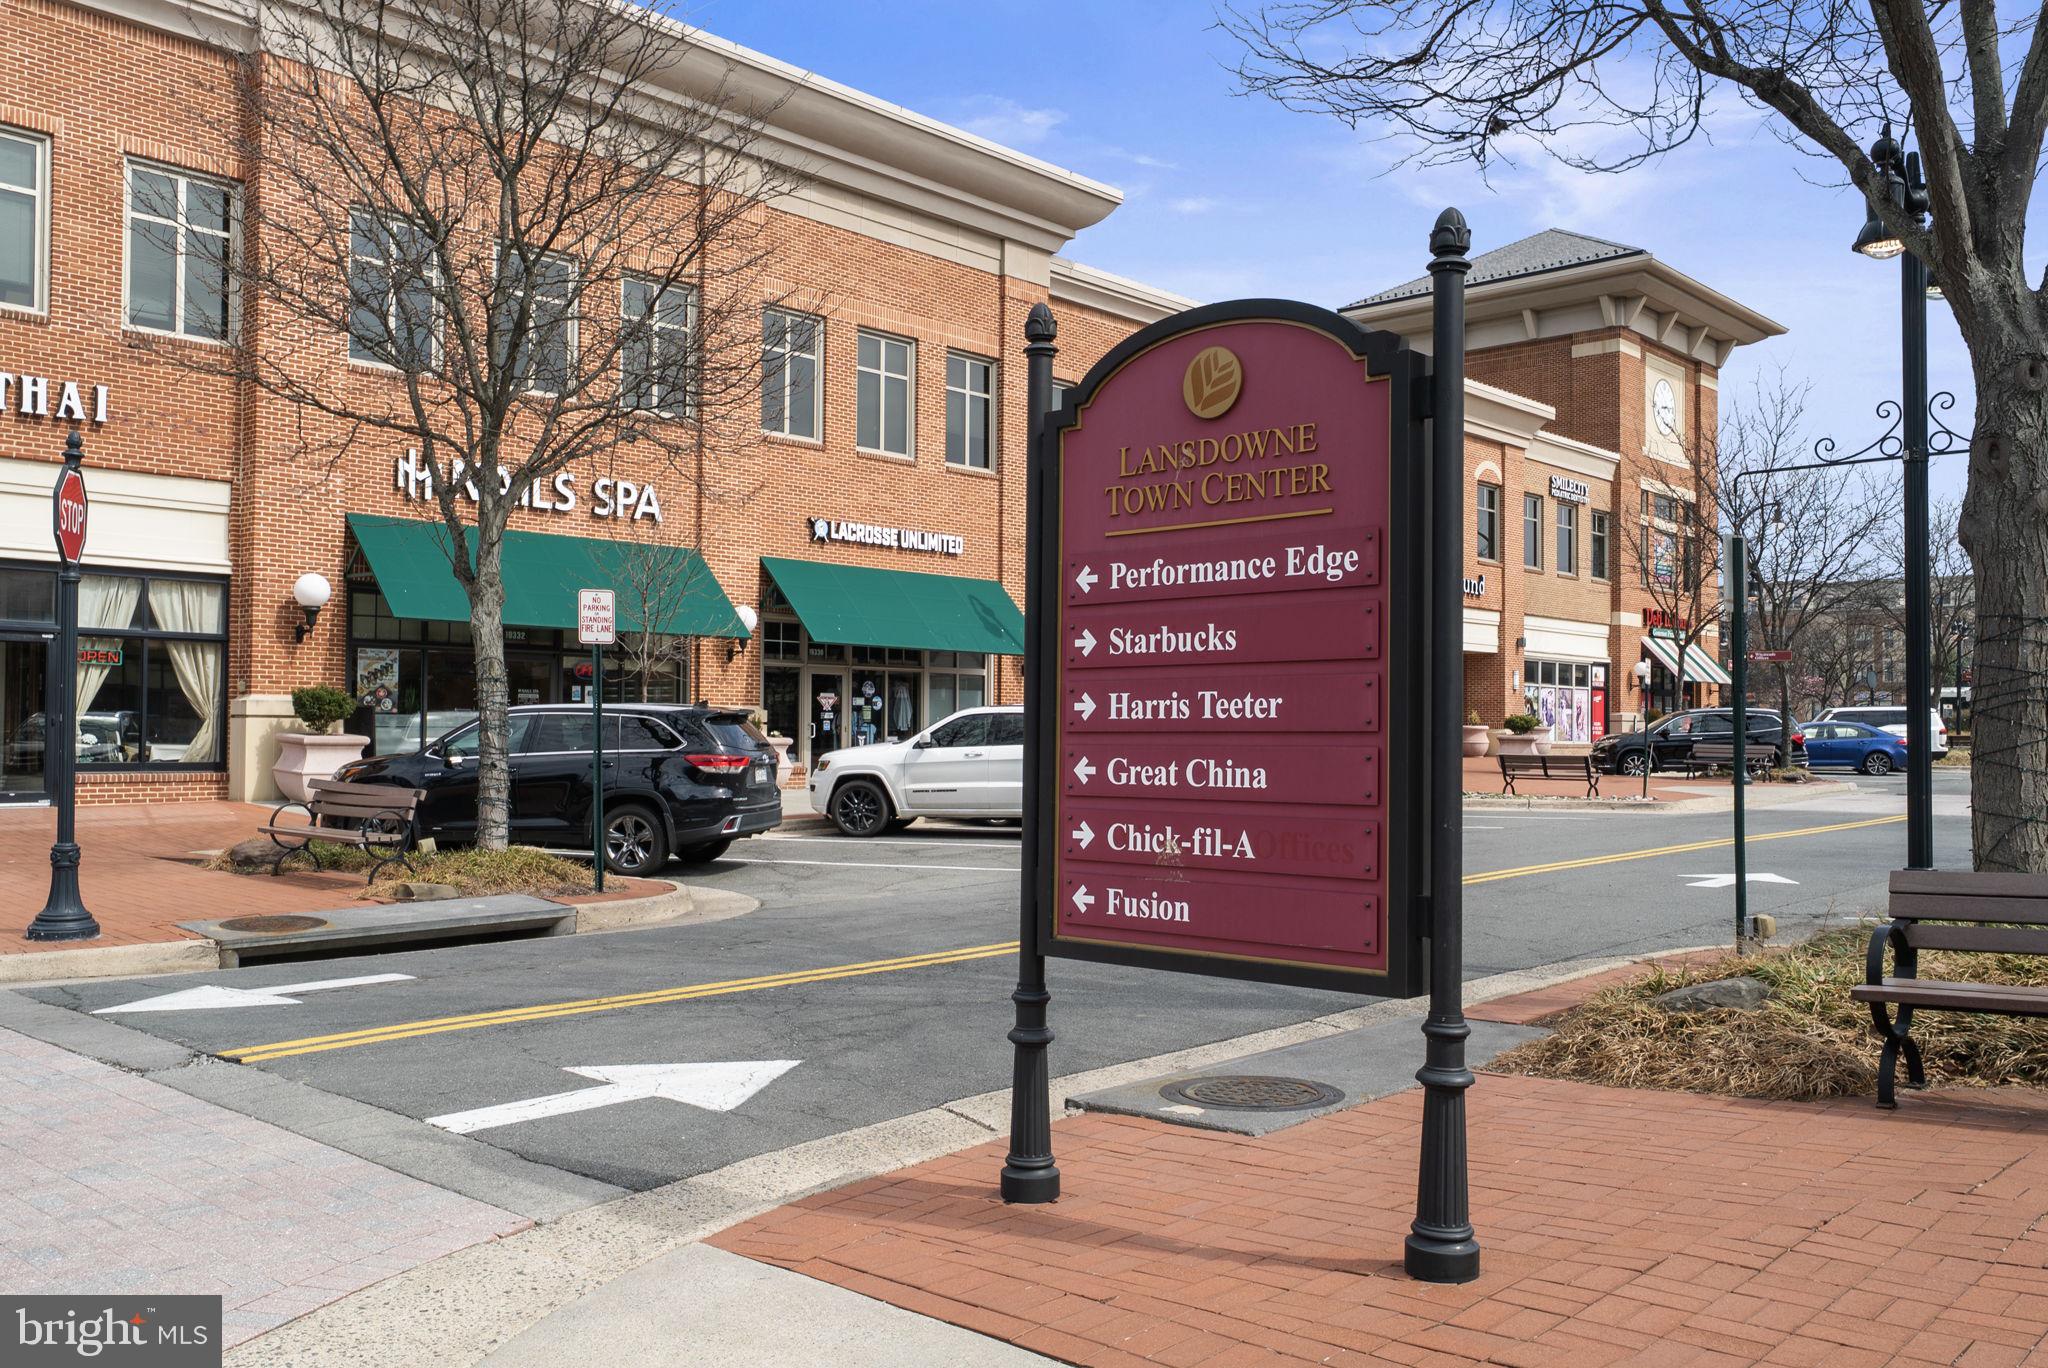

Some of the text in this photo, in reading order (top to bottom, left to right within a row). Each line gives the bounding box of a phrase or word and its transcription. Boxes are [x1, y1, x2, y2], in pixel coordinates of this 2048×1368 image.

[0, 372, 108, 422] THAI
[1119, 422, 1320, 478] LANSDOWNE
[593, 477, 663, 522] SPA
[1105, 463, 1333, 517] TOWN CENTER
[1551, 475, 1590, 497] SMILECITY
[60, 498, 84, 535] STOP
[830, 520, 964, 554] LACROSSE UNLIMITED
[1109, 545, 1359, 590] Performance Edge
[581, 624, 612, 633] FIRE LANE
[1109, 623, 1237, 654] Starbucks
[1108, 691, 1283, 720] Harris Teeter
[1107, 758, 1267, 789] Great China
[1107, 822, 1256, 859] Chick-fil-A
[1106, 888, 1190, 922] Fusion
